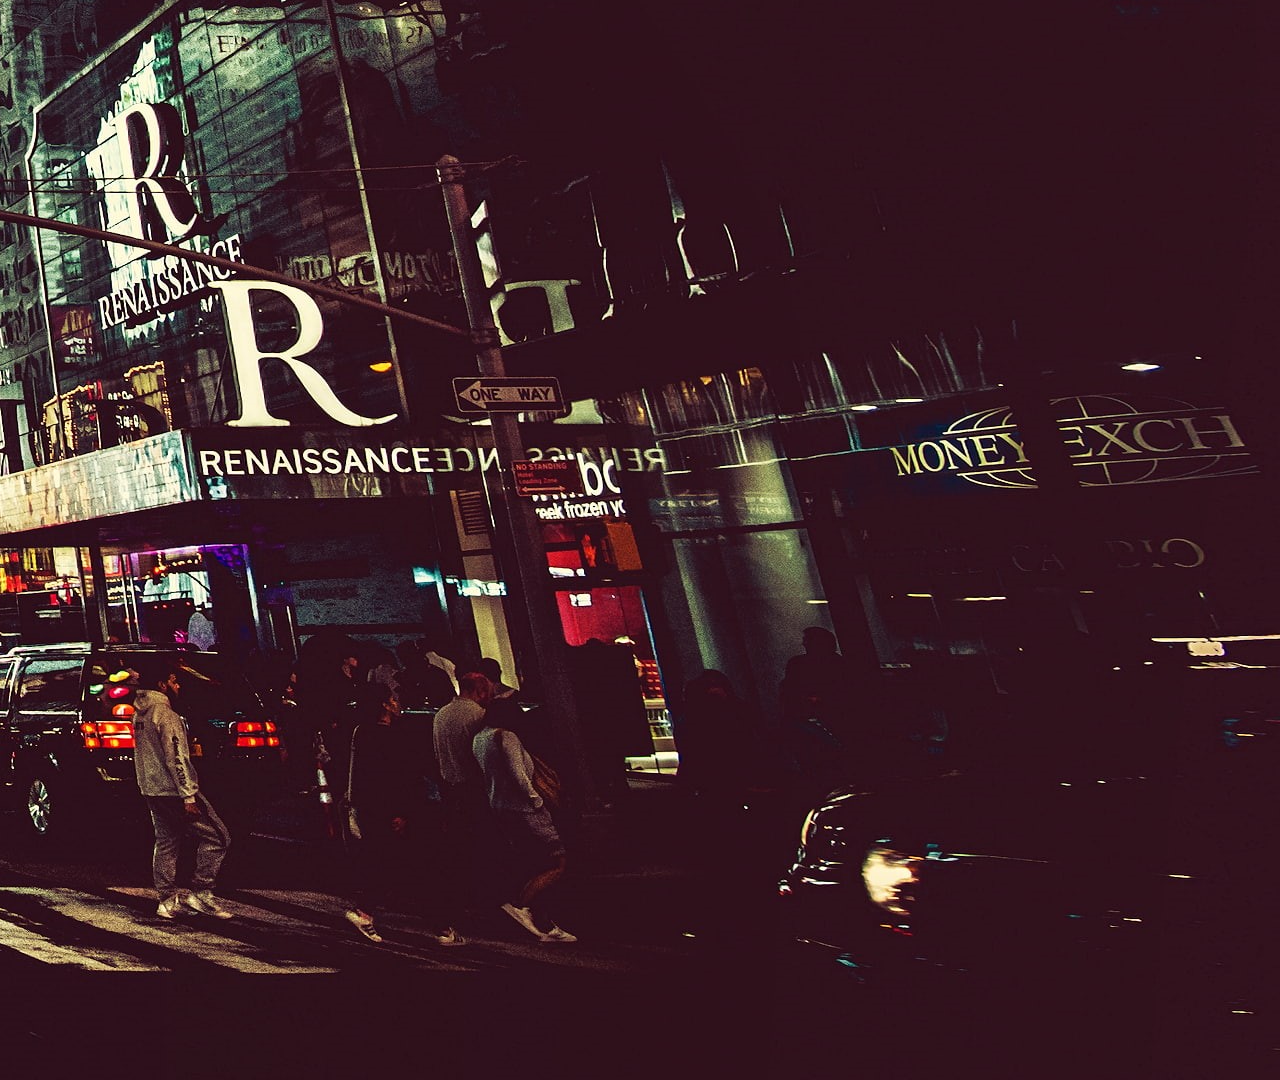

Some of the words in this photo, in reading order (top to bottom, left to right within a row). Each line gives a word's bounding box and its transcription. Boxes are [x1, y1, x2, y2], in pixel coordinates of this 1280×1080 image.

[109, 102, 198, 257] R
[98, 233, 246, 331] RENAISSANCE
[207, 279, 399, 428] R
[469, 388, 502, 401] ONE
[518, 387, 551, 401] WAY
[200, 446, 433, 476] RENAISSANCE
[530, 463, 567, 471] STANDING
[890, 432, 1030, 477] MONEY
[1057, 414, 1246, 459] EXCH
[564, 500, 609, 519] frozen
